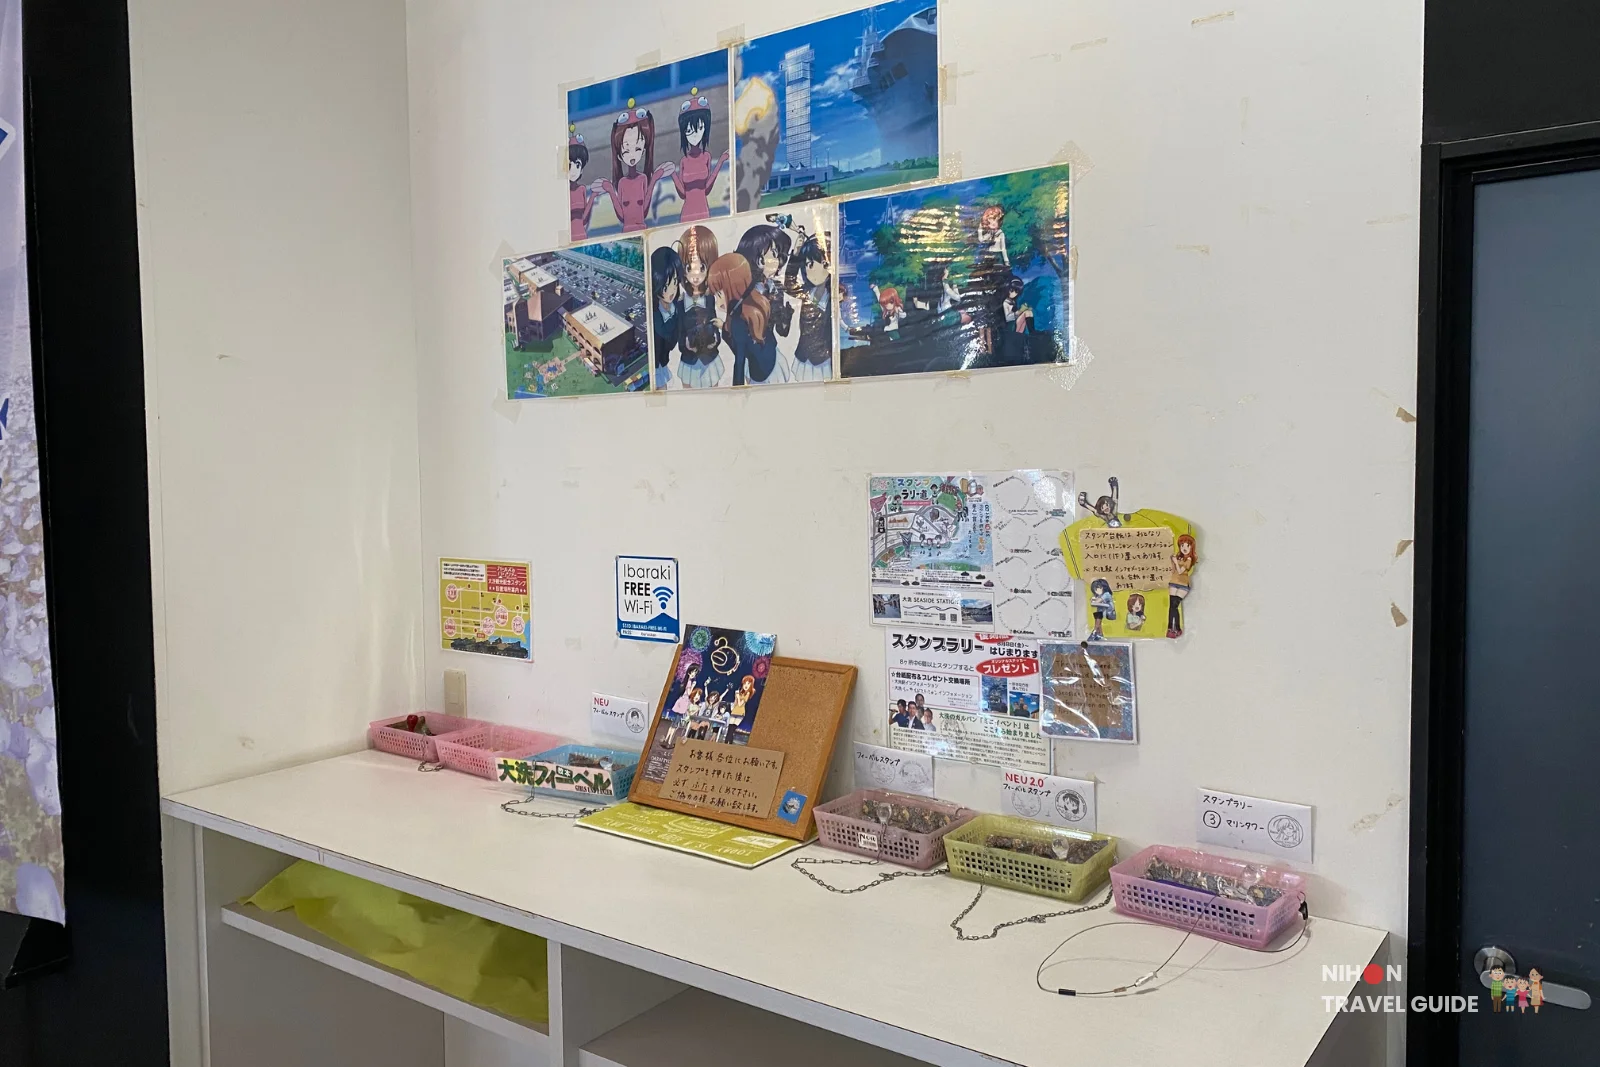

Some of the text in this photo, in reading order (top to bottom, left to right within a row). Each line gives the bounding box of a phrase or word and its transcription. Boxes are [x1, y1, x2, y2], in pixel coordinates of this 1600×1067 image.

[623, 563, 671, 580] Ibaraki
[624, 581, 651, 597] FREE
[624, 599, 653, 614] Wi-Fi
[892, 633, 985, 654] スタンプラリー
[990, 647, 1039, 659] はじまります
[593, 697, 610, 707] NEU
[1203, 795, 1253, 809] スタンプラリー
[1226, 819, 1265, 831] マリンタワー
